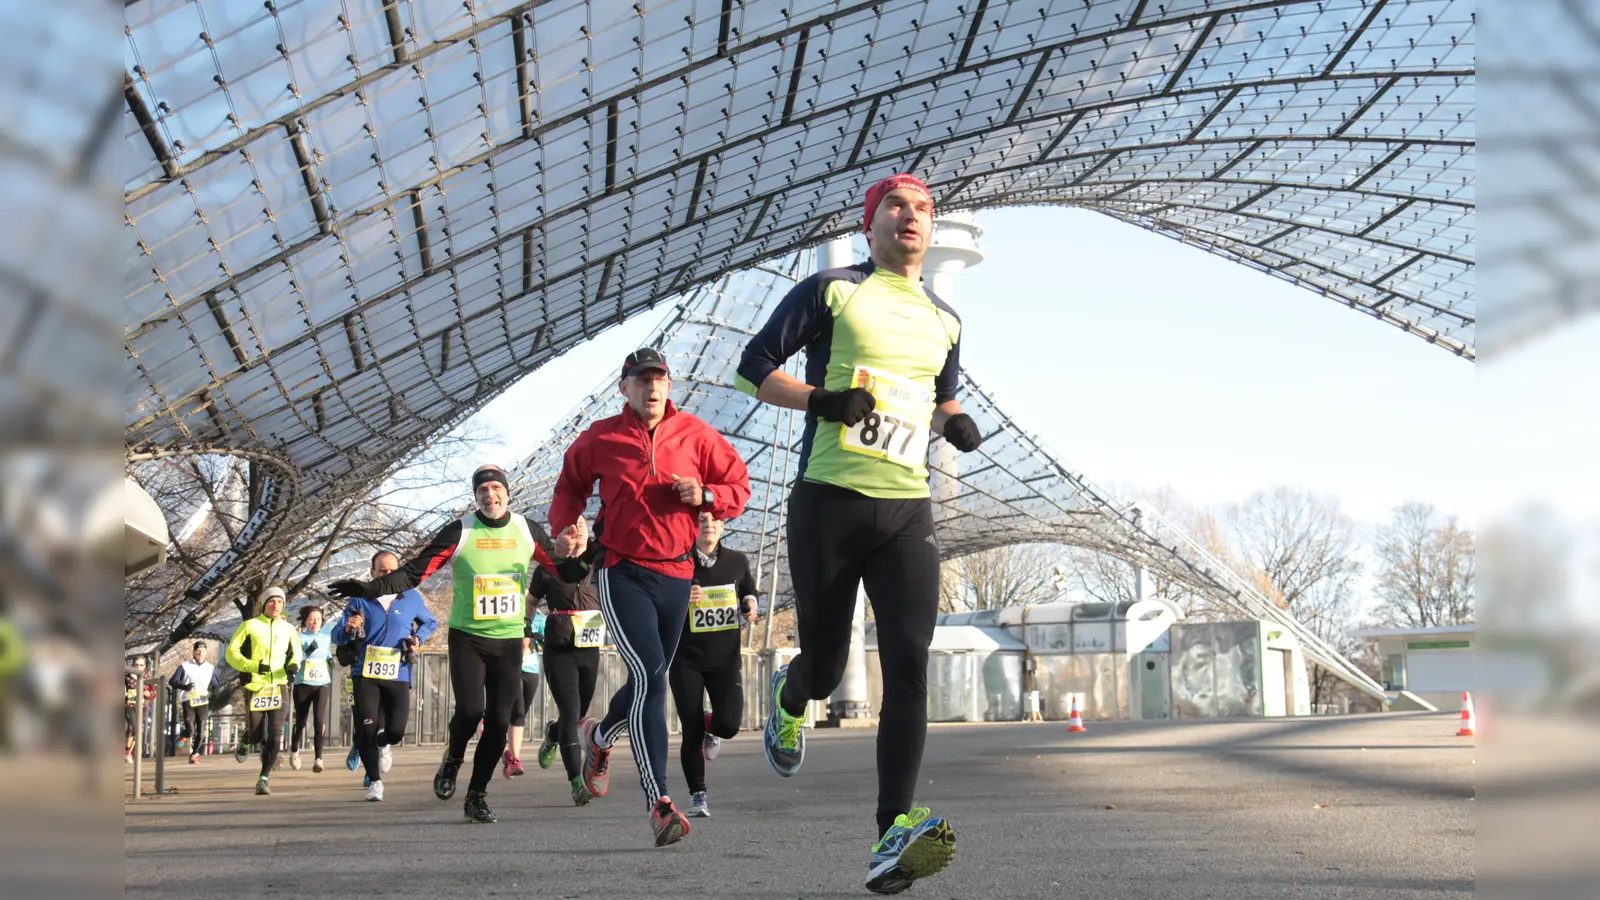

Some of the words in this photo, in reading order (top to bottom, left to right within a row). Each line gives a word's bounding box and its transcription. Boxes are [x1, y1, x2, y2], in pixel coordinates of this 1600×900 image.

[860, 412, 917, 455] 877
[479, 594, 516, 615] 1151
[695, 607, 735, 628] 2632
[581, 628, 600, 643] 505
[368, 661, 396, 676] 1393
[254, 696, 279, 708] 2575
